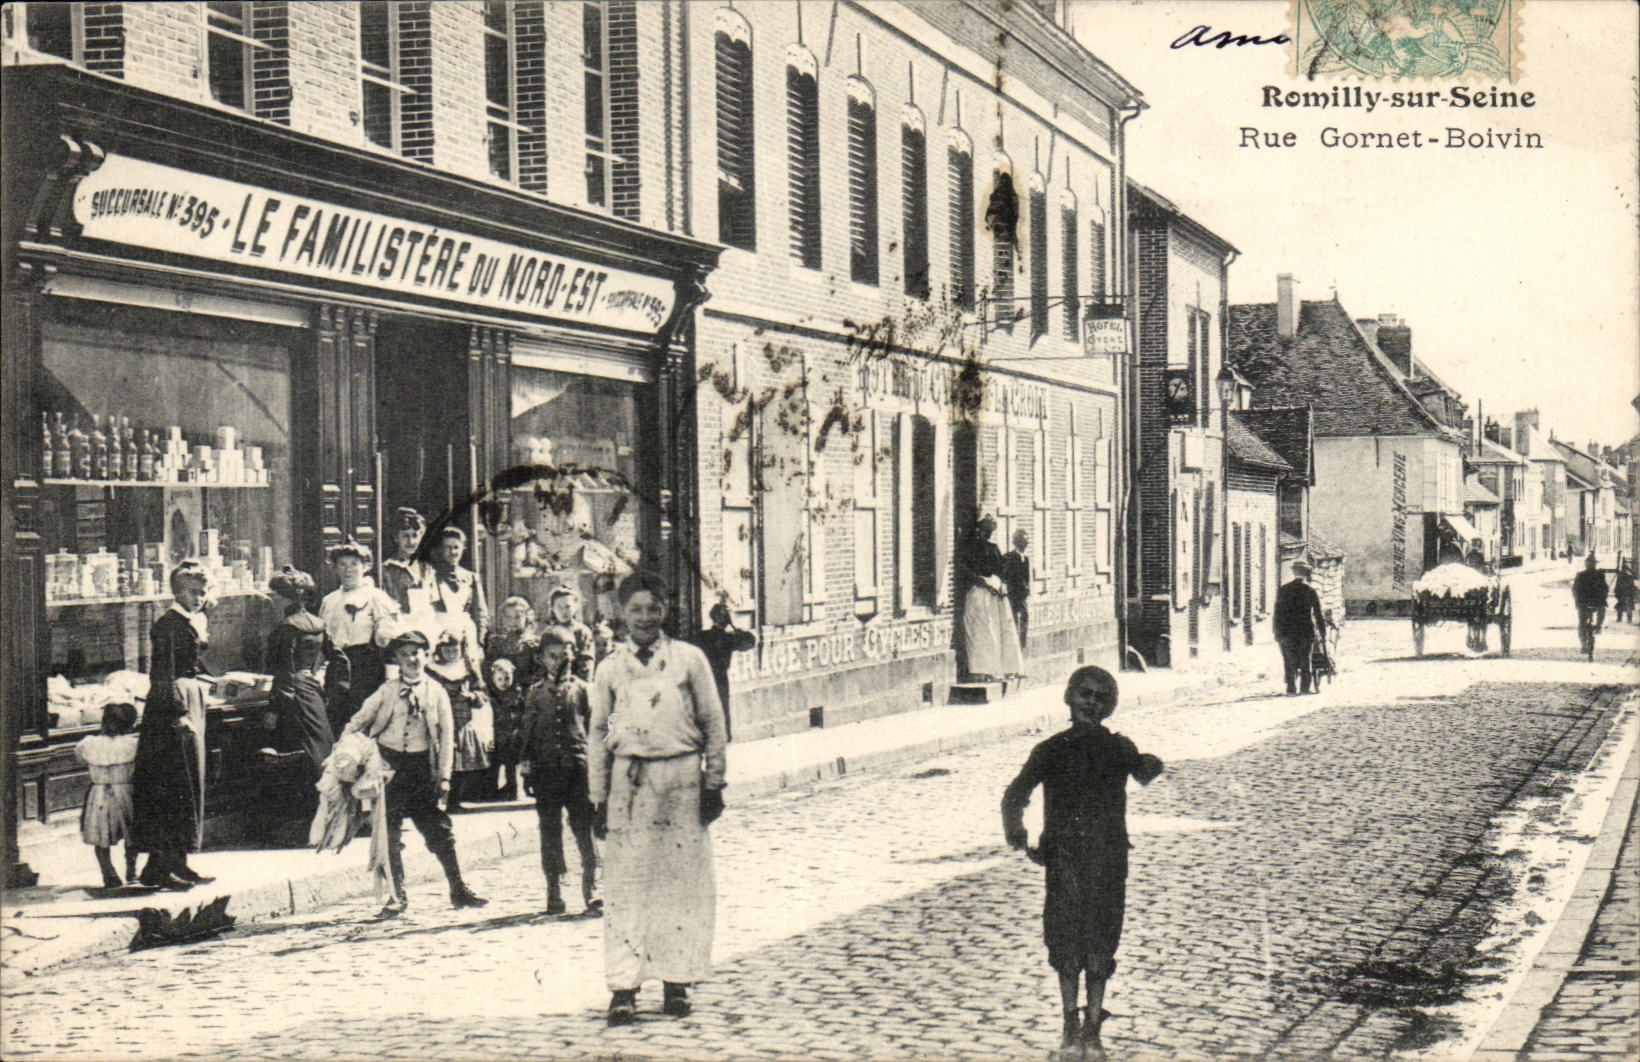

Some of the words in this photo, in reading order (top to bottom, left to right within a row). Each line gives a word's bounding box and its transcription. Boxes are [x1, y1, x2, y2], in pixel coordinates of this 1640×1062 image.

[91, 188, 168, 220] SUCCURSALE
[230, 193, 280, 258] LE
[467, 253, 500, 297] DU
[805, 633, 856, 671] POUR
[862, 625, 930, 664] CYCLES
